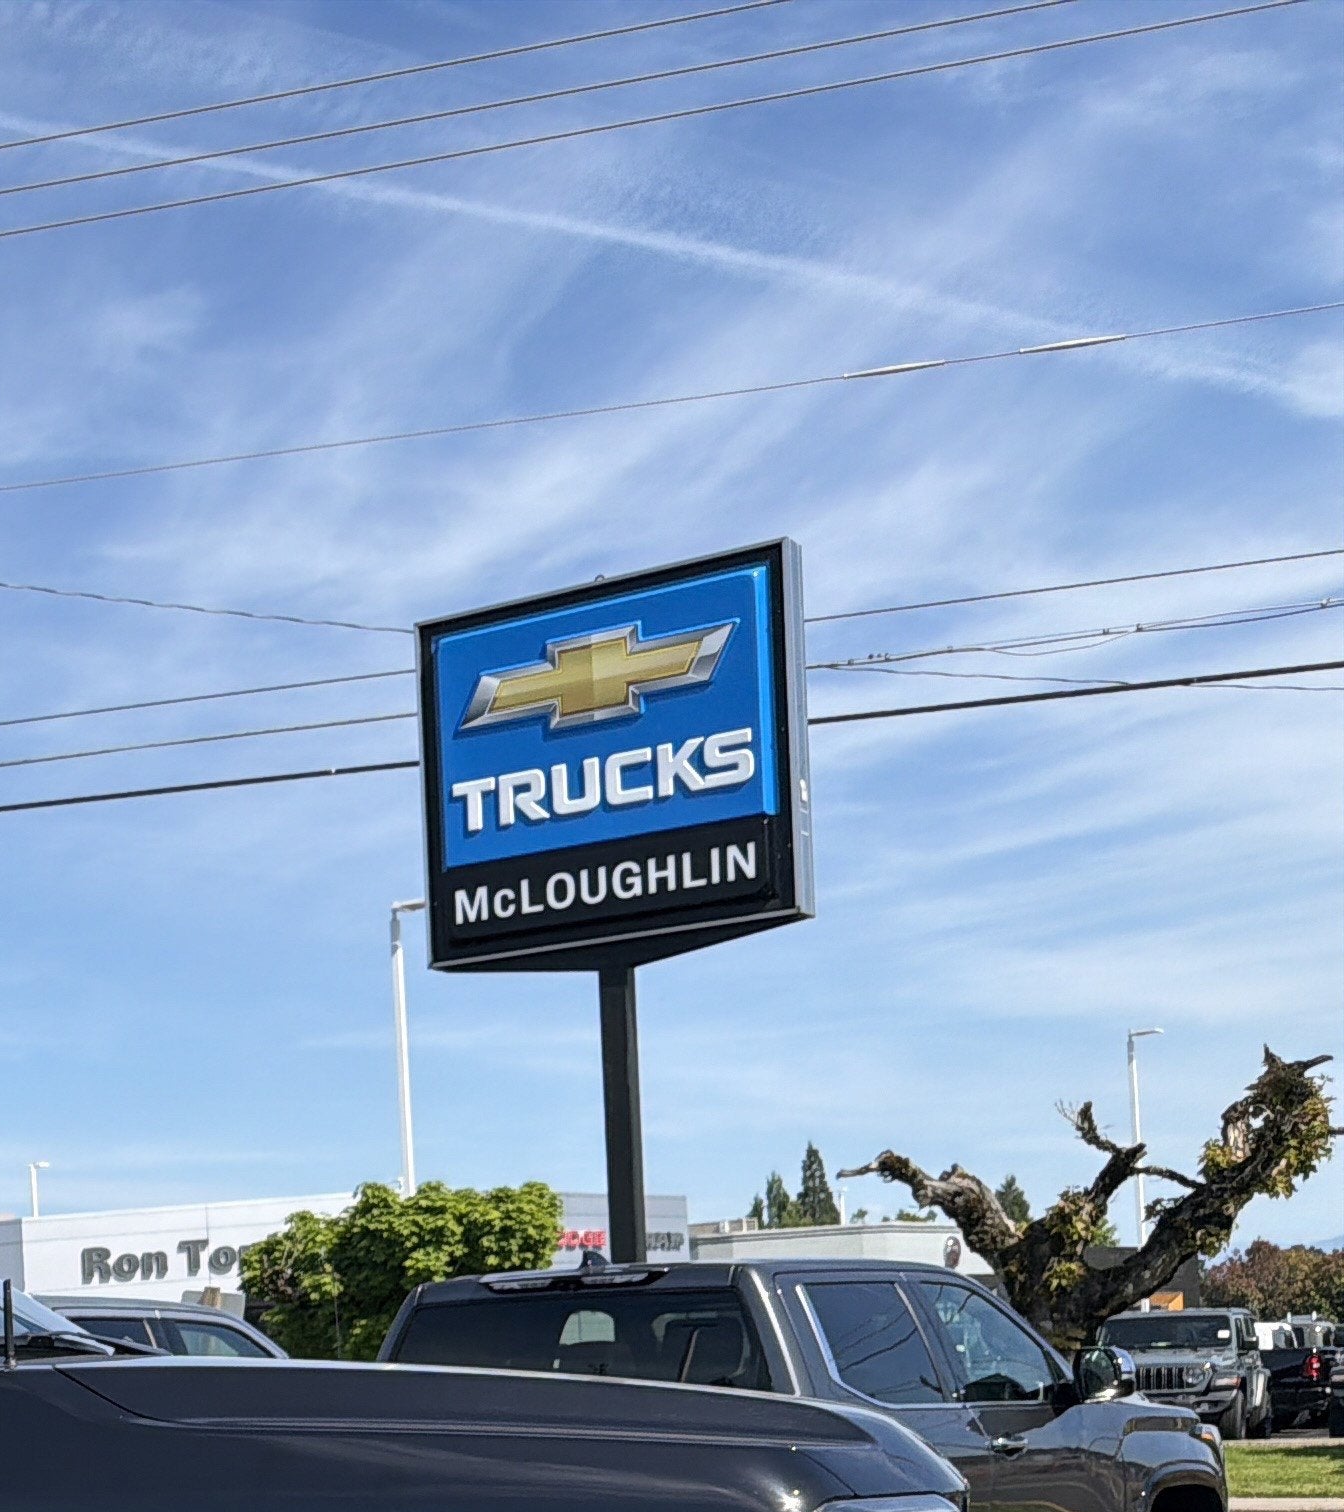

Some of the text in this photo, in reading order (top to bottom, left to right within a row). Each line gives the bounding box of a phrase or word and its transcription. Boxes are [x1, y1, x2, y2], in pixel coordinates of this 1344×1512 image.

[452, 727, 755, 832] TRUCKS
[455, 841, 757, 926] McLOUGHLIN
[81, 1247, 169, 1285] Ron
